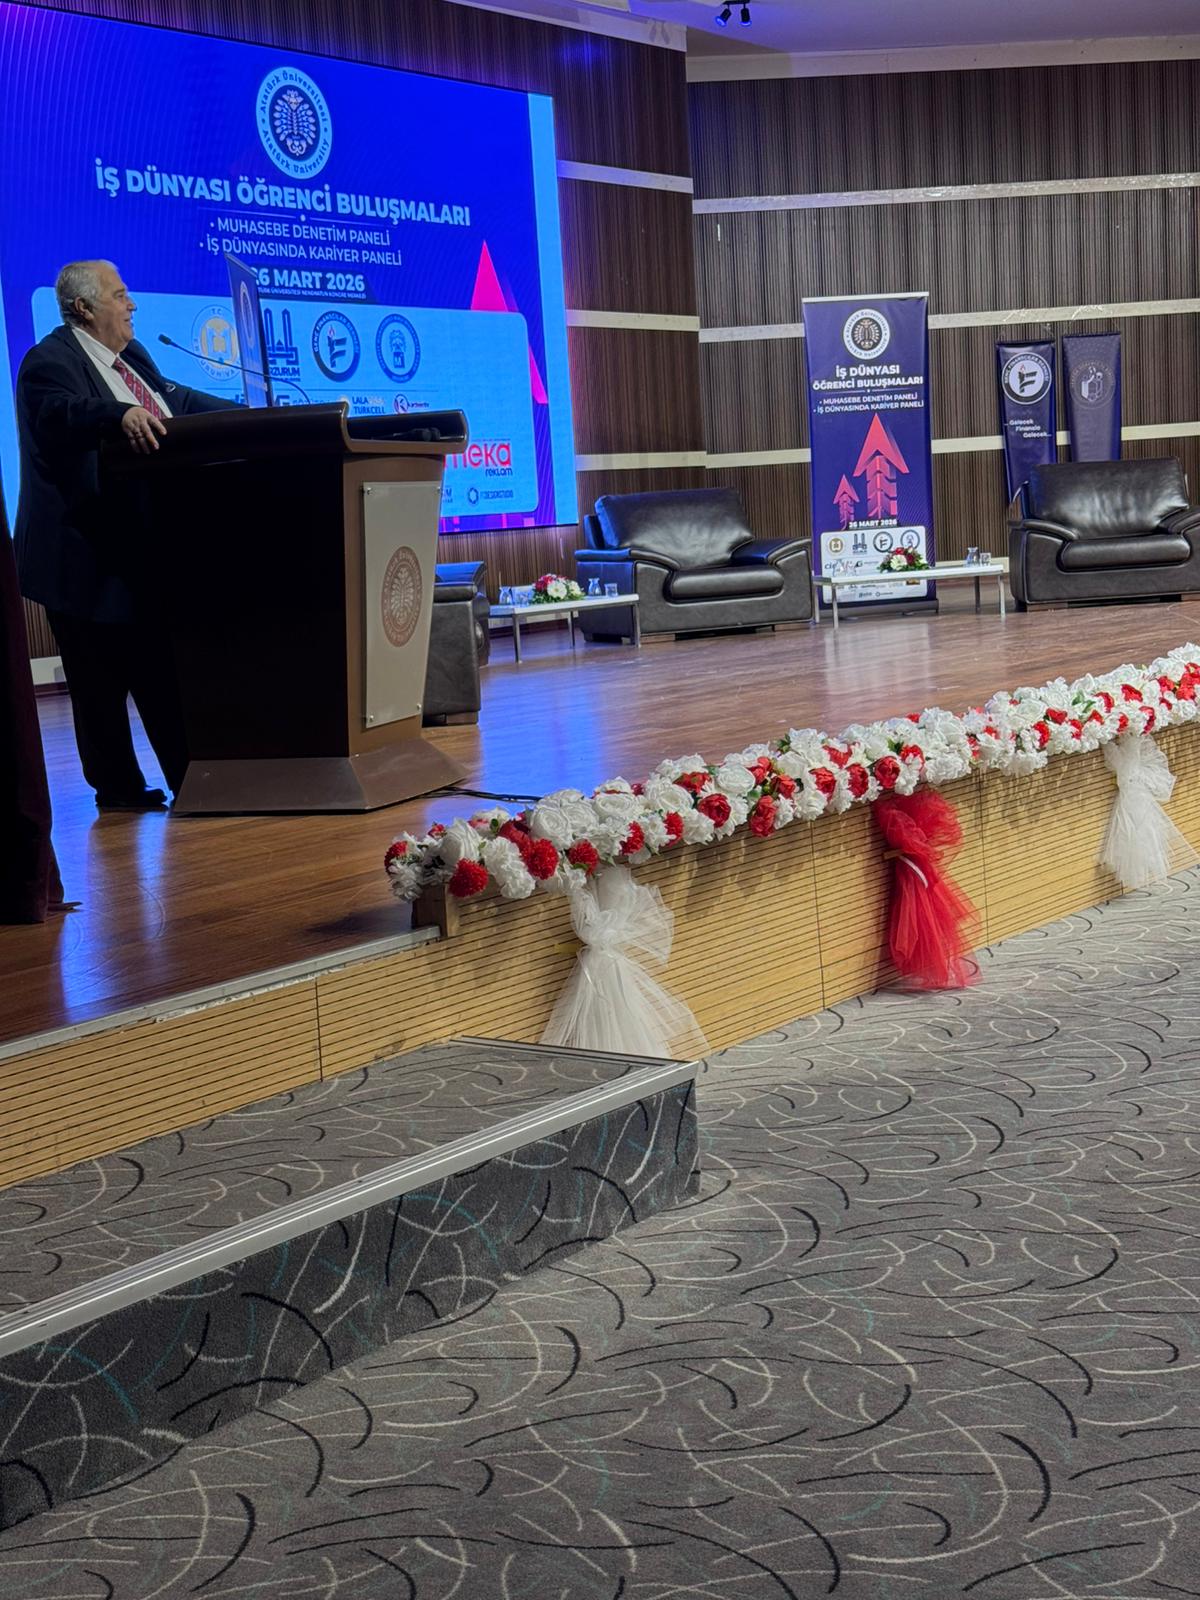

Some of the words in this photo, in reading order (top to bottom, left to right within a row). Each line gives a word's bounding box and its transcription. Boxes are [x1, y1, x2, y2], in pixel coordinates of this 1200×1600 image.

[95, 157, 120, 198] İŞ
[126, 165, 232, 202] DÜNYASI
[236, 175, 332, 213] ÖĞRENCİ
[336, 192, 471, 226] BULUŞMALARI
[217, 217, 291, 238] MUHASEBE
[292, 224, 348, 243] DENETİM
[349, 229, 391, 246] PANELİ
[206, 234, 220, 256] İŞ
[222, 237, 308, 259] DÜNYASINDA
[308, 247, 359, 264] KARİYER
[361, 250, 402, 266] PANELİ
[273, 268, 323, 289] MART
[325, 272, 366, 292] 2026
[835, 365, 847, 379] İŞ
[849, 364, 900, 377] DÜNYASI
[812, 378, 855, 391] ÖĞRENCİ
[857, 375, 924, 388] BULUŞMALARI
[823, 396, 861, 405] MUHASEBE
[862, 394, 893, 403] DENETİM
[894, 392, 918, 401] PANELİ
[824, 405, 870, 413] DÜNYASINDA
[870, 401, 899, 411] KARİYER
[900, 400, 924, 409] PANELİ
